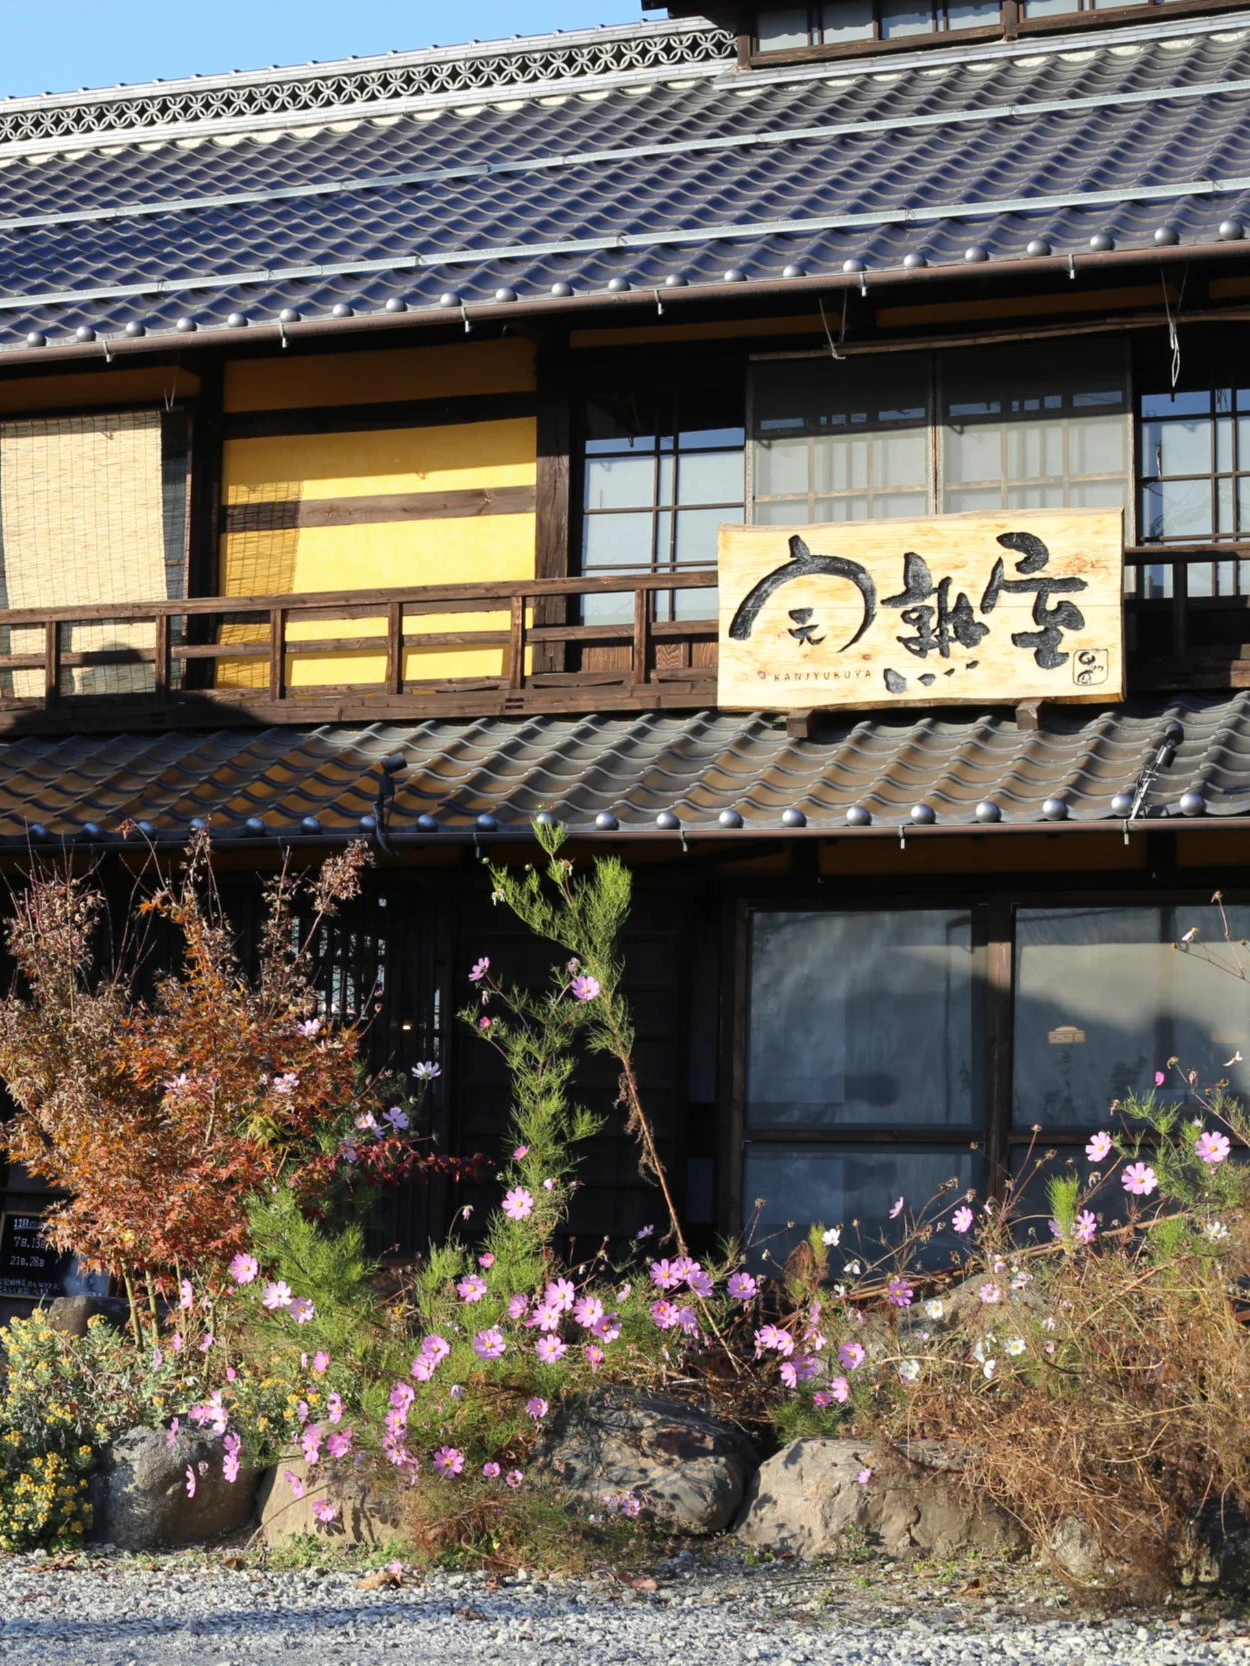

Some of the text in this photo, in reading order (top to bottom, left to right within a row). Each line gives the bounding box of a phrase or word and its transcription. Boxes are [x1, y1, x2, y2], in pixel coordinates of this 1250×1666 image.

[729, 531, 1089, 694] 完熟屋
[774, 669, 872, 682] KANJYUKUYA
